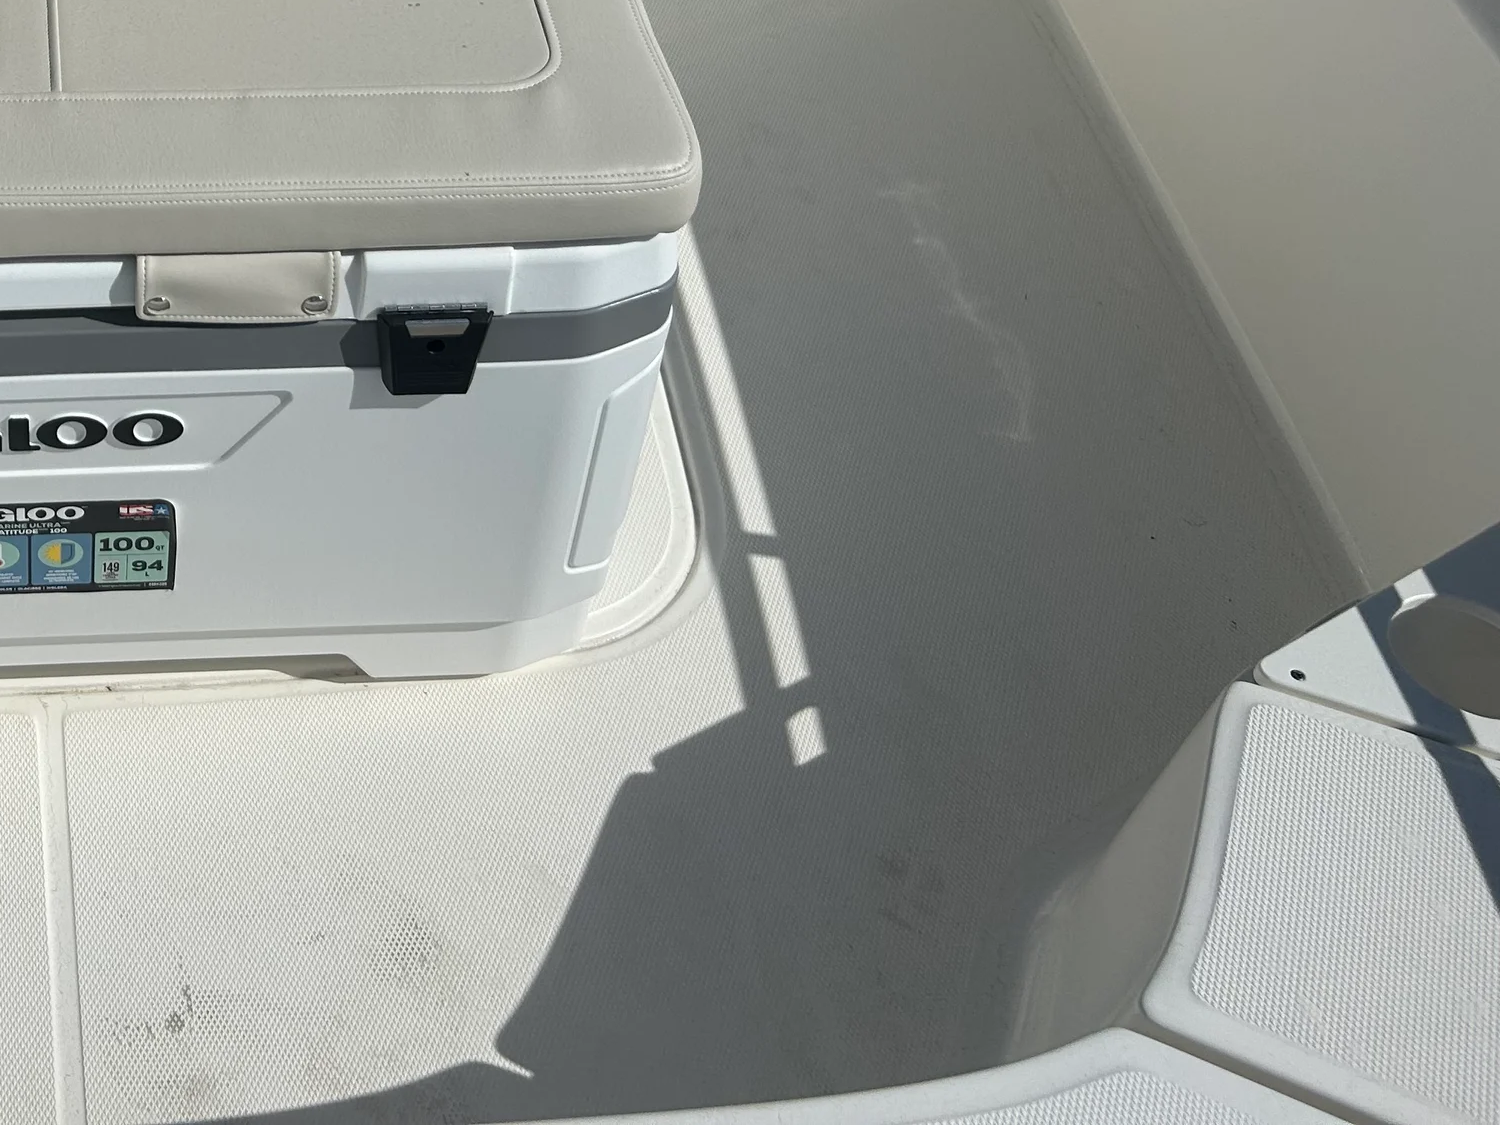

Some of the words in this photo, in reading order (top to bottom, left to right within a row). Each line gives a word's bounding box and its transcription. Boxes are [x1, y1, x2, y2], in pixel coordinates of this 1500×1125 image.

[99, 536, 155, 551] 100
[102, 561, 120, 572] 149
[131, 559, 164, 571] 94
